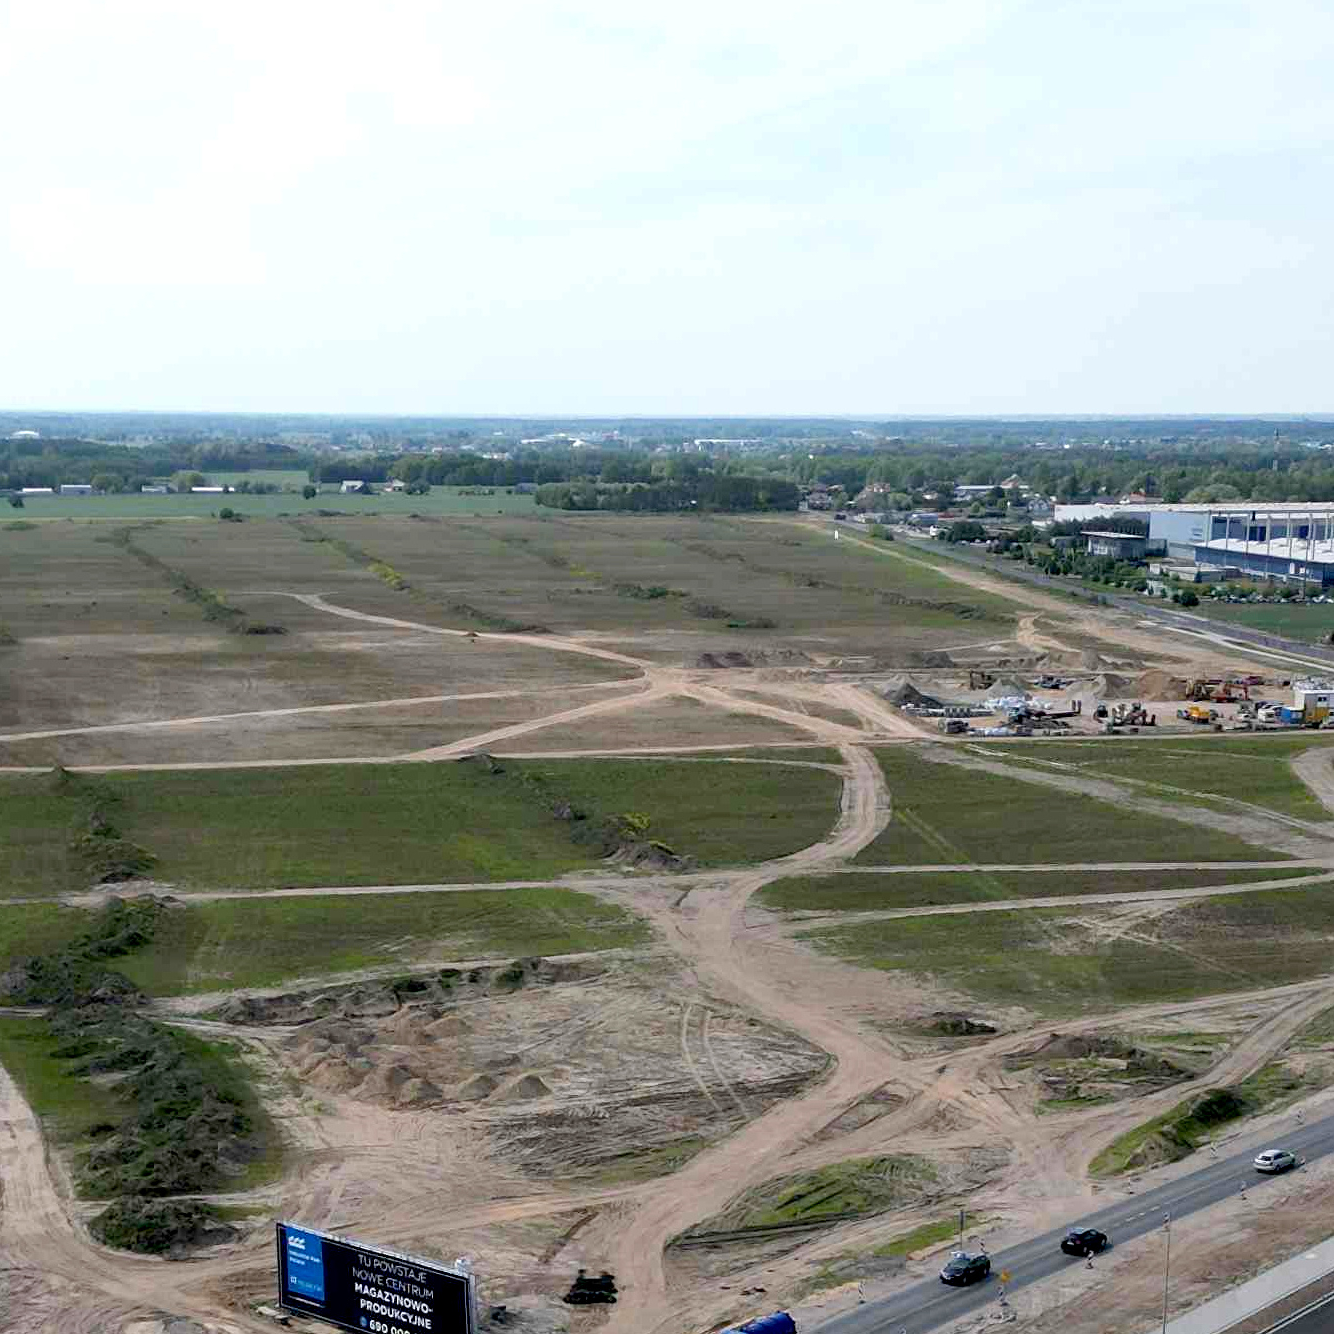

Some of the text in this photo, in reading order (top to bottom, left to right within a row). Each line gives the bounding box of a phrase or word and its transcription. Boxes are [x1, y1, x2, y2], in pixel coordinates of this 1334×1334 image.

[352, 1266, 434, 1299] NOWE CENTRUM
[358, 1254, 427, 1283] TU POWSTAJE
[354, 1282, 434, 1313] MAGAZYNOWO-
[360, 1298, 432, 1330] PRODUKCYJNE
